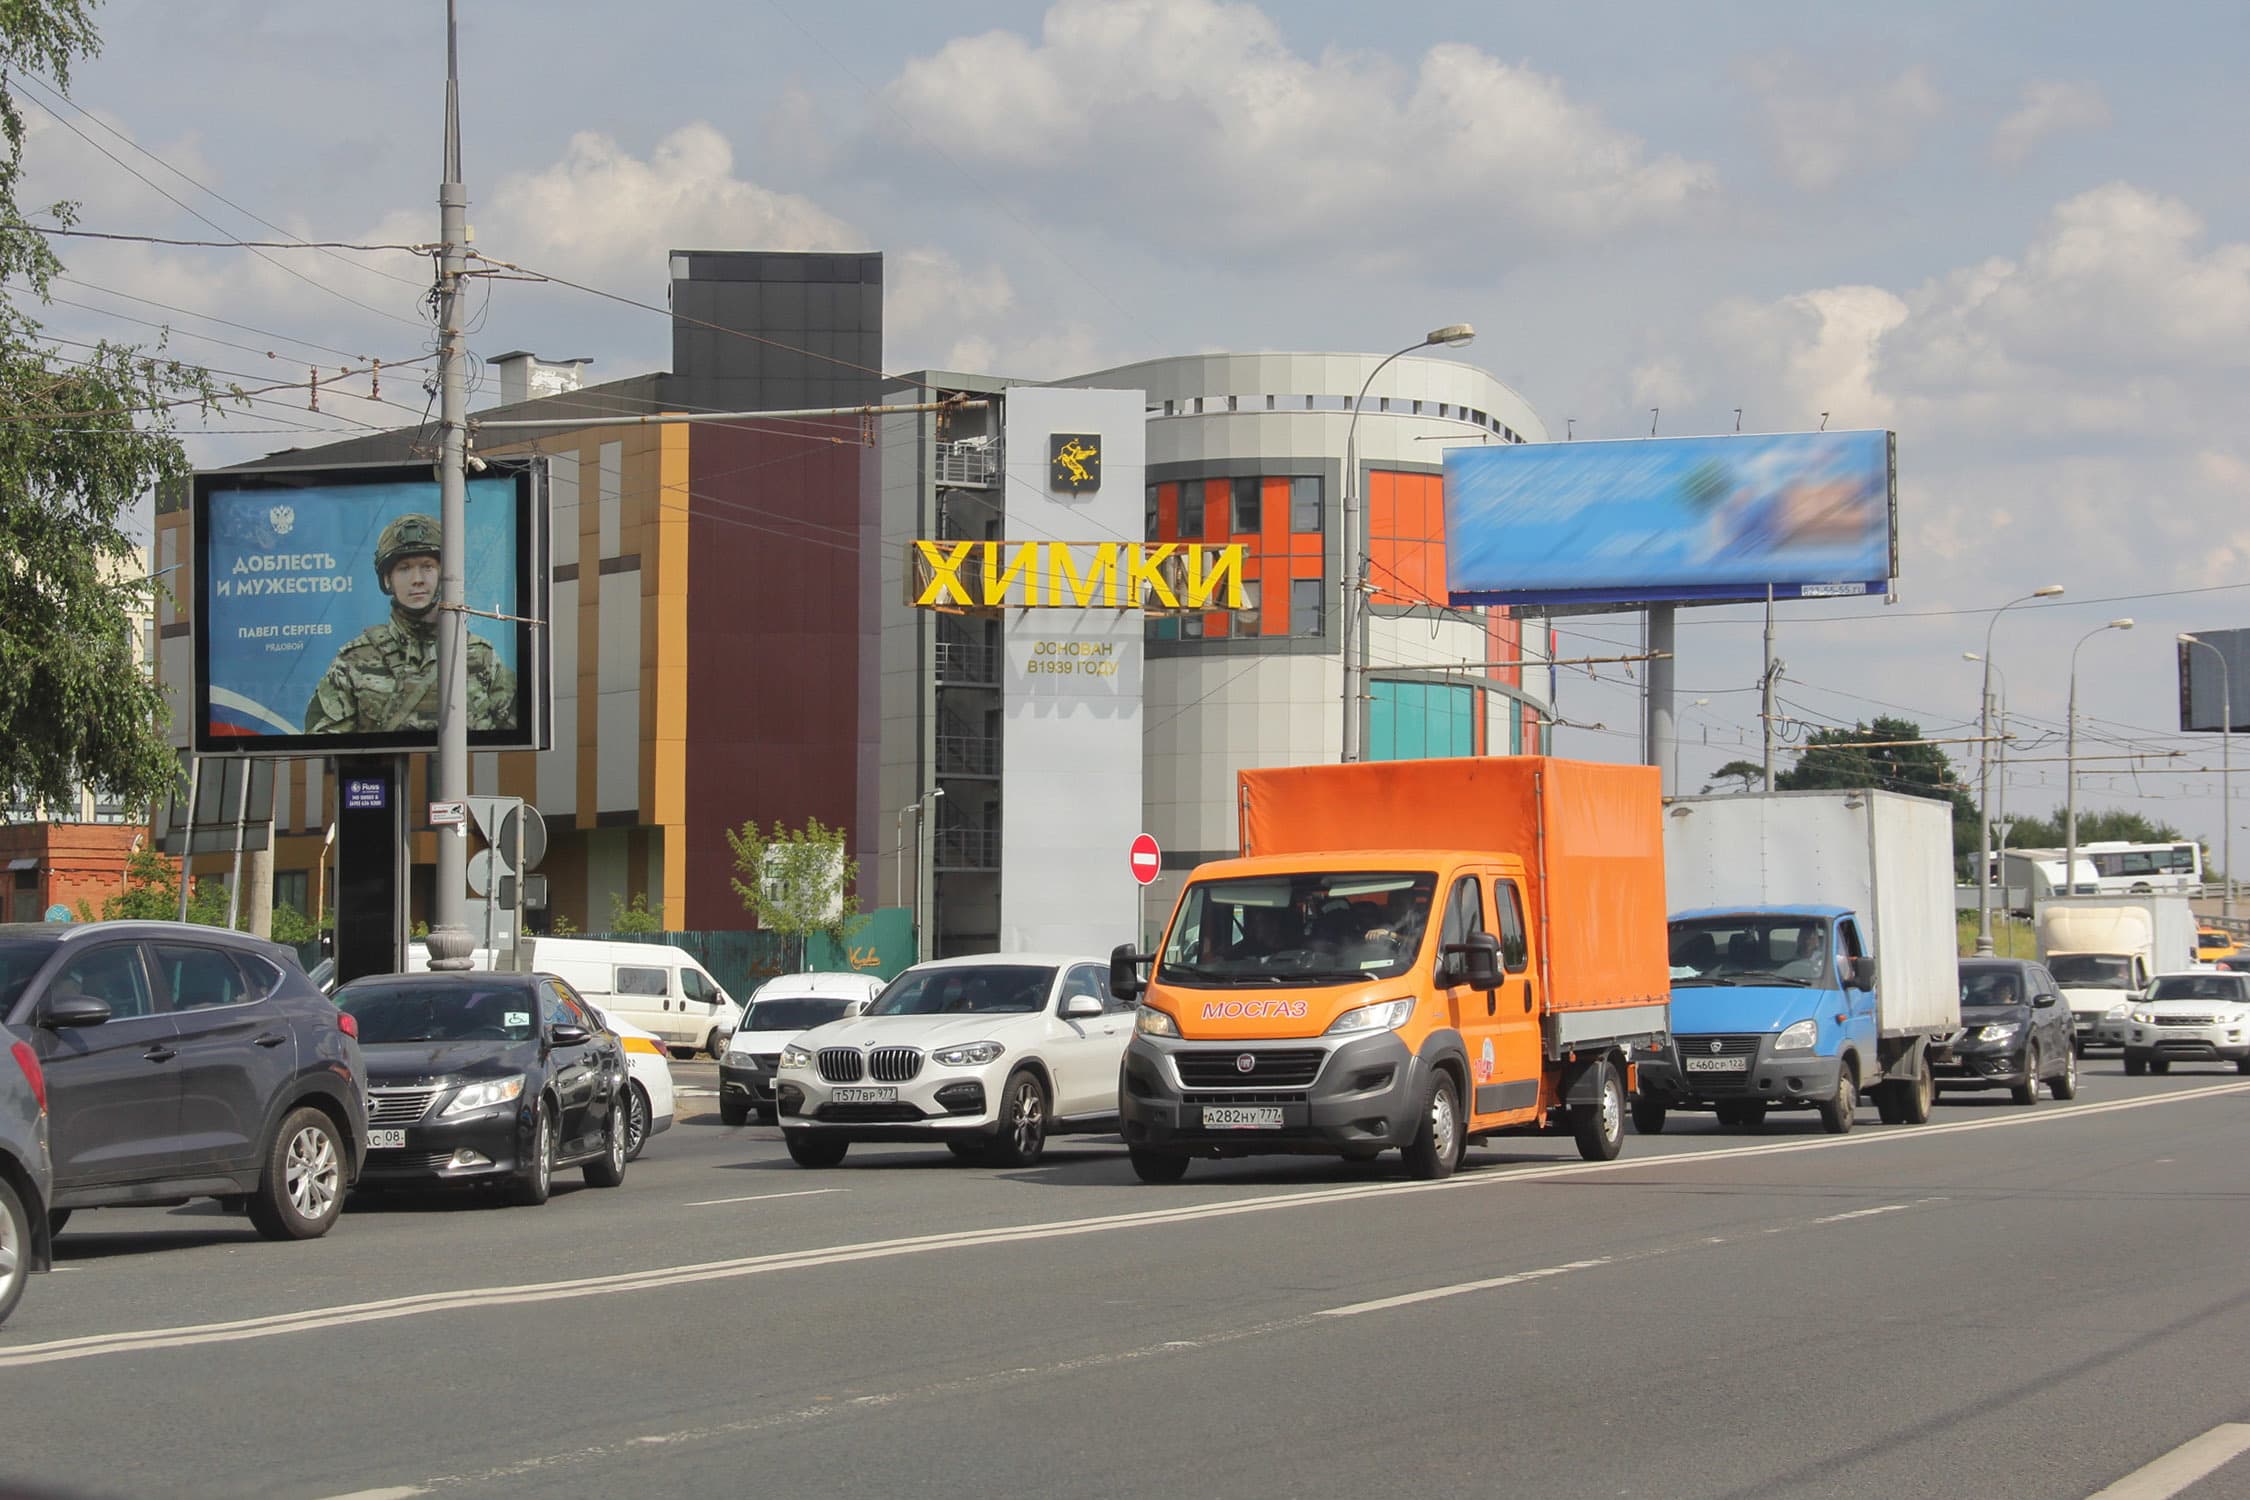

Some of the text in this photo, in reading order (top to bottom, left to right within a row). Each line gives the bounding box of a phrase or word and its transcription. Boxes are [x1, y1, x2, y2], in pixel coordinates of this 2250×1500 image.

[232, 552, 337, 575] ДОБЛЕСТЬ
[915, 540, 1243, 609] ХИМКИ
[216, 575, 353, 597] И МУЖЕСТВО!
[238, 623, 333, 639] ПАВЕЛ СЕРГЕЕВ
[264, 640, 305, 652] РЯДОВОЙ
[1033, 641, 1113, 657] ОСНОВАН
[1076, 660, 1119, 677] ГОДУ
[1201, 999, 1309, 1021] МОСГАЗ
[1207, 1108, 1279, 1124] А282НУ 777
